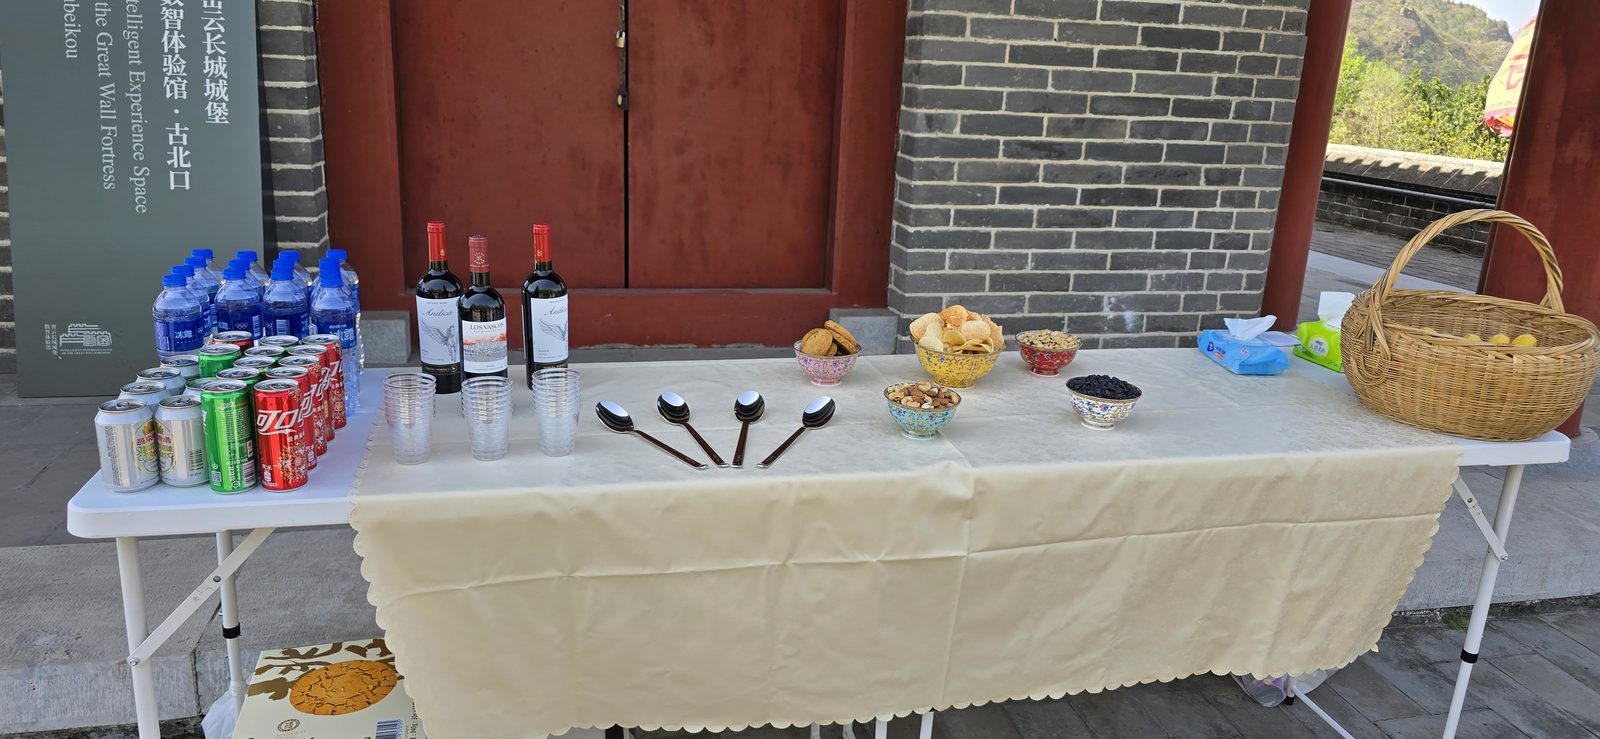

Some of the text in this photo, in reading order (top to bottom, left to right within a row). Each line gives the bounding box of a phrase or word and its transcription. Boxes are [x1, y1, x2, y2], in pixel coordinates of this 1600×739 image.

[94, 2, 118, 190] the Great Wall Fortress
[125, 70, 148, 161] Experience
[160, 0, 192, 190] 智体验馆·古北口
[129, 166, 150, 214] Space
